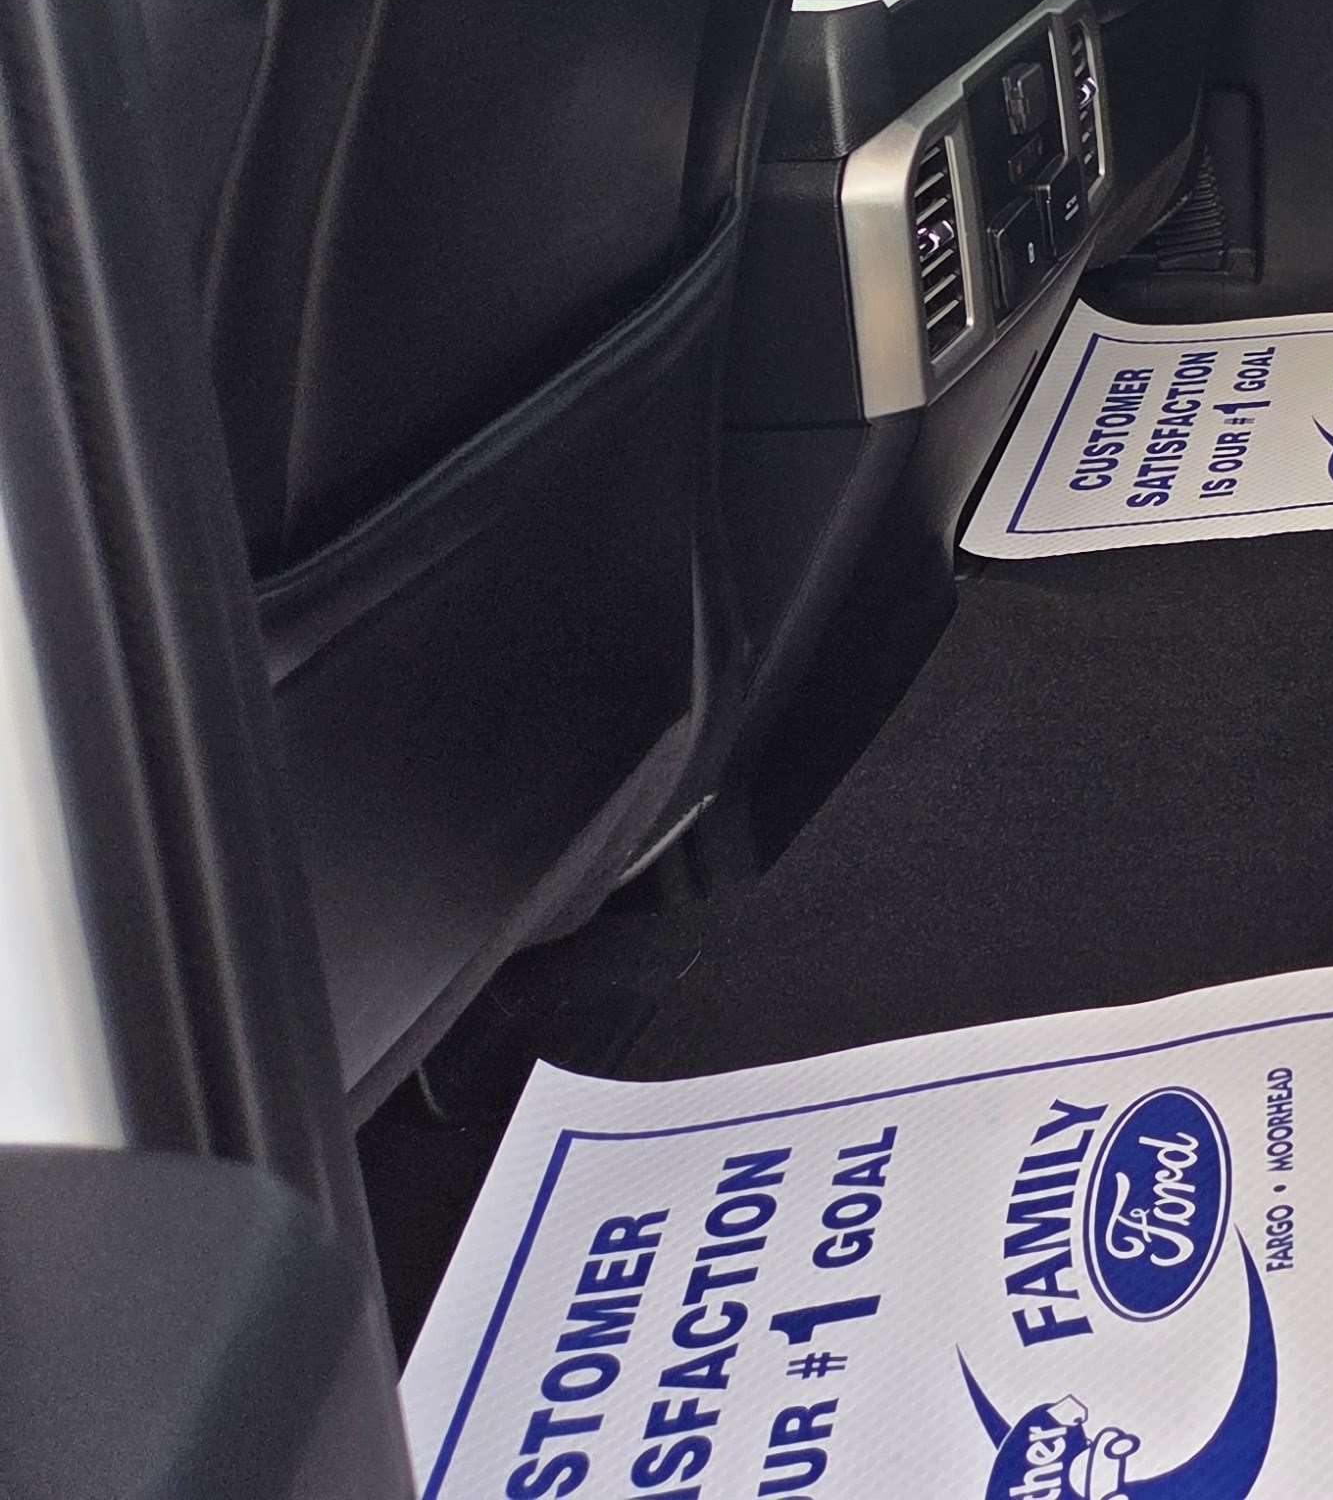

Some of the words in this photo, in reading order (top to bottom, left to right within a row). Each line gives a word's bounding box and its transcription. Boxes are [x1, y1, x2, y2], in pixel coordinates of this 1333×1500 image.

[1232, 346, 1276, 392] GOAL
[1069, 367, 1155, 491] CUSTOMER
[1126, 350, 1219, 508] SATISFACTION
[1208, 431, 1252, 474] OUR
[1199, 477, 1238, 499] IS
[1266, 1066, 1293, 1173] MOORHEAD
[1004, 1098, 1109, 1347] FAMILY
[1106, 1131, 1201, 1268] Ford
[1266, 1202, 1294, 1274] FARGO
[756, 1397, 840, 1500] UR
[811, 1124, 898, 1269] GOAL
